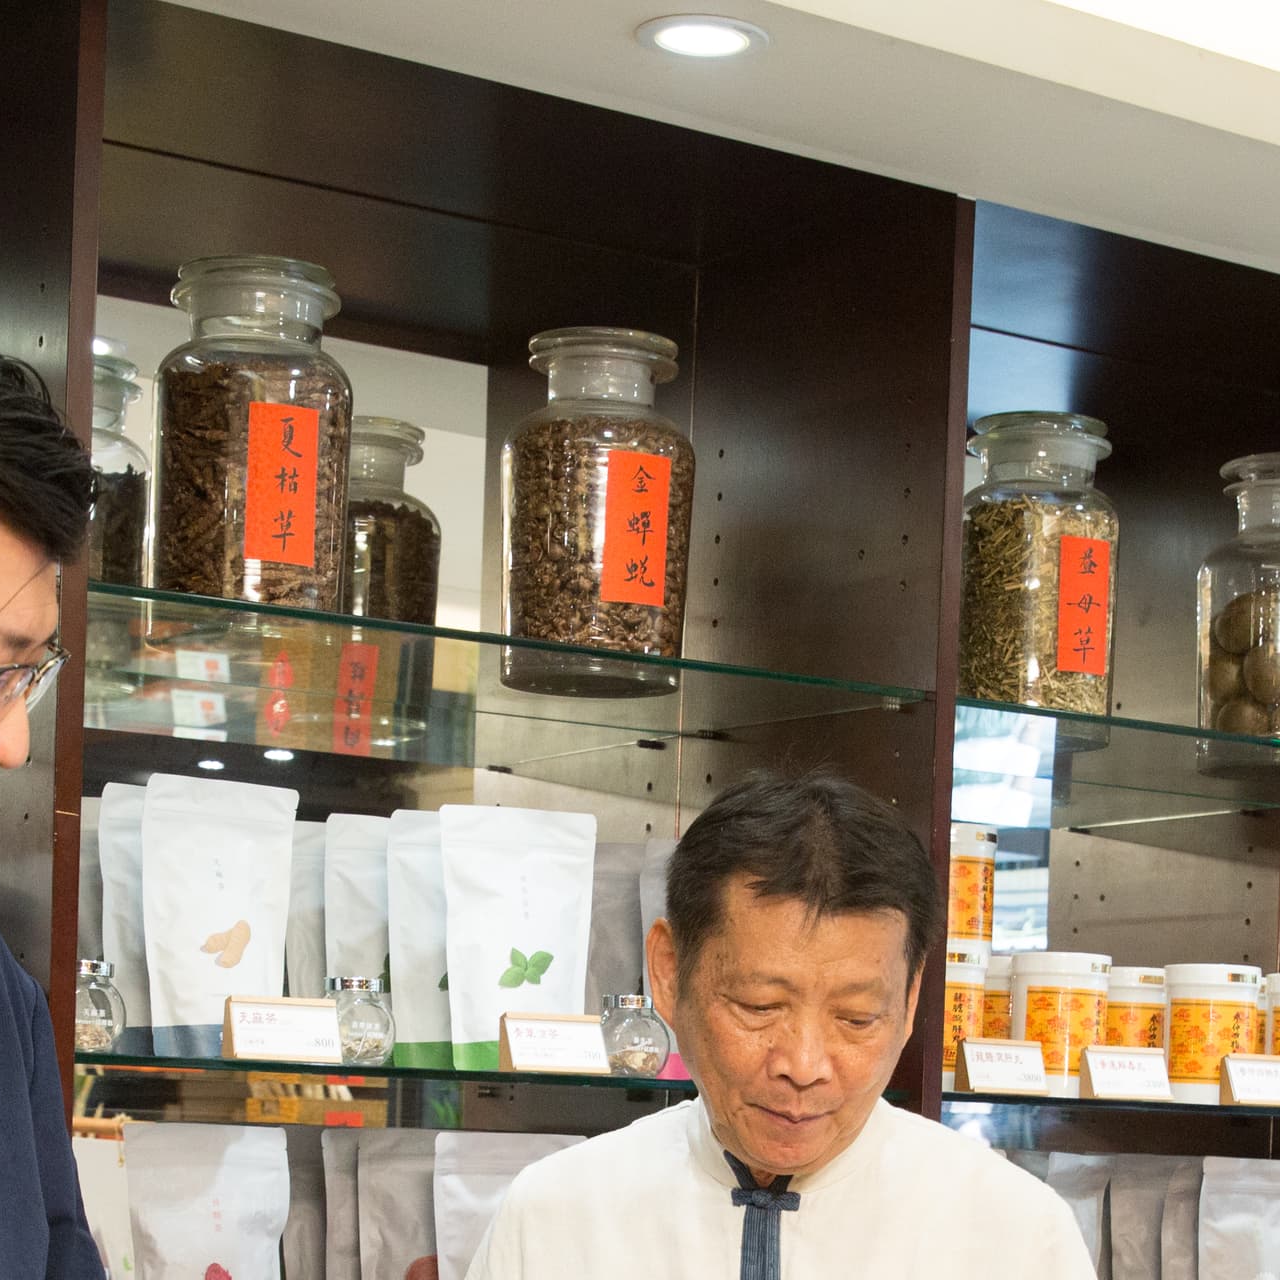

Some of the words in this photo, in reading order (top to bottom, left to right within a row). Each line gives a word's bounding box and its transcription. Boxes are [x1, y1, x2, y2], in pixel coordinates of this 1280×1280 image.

[269, 415, 301, 554] 夏枯草
[1065, 546, 1101, 666] 益母草
